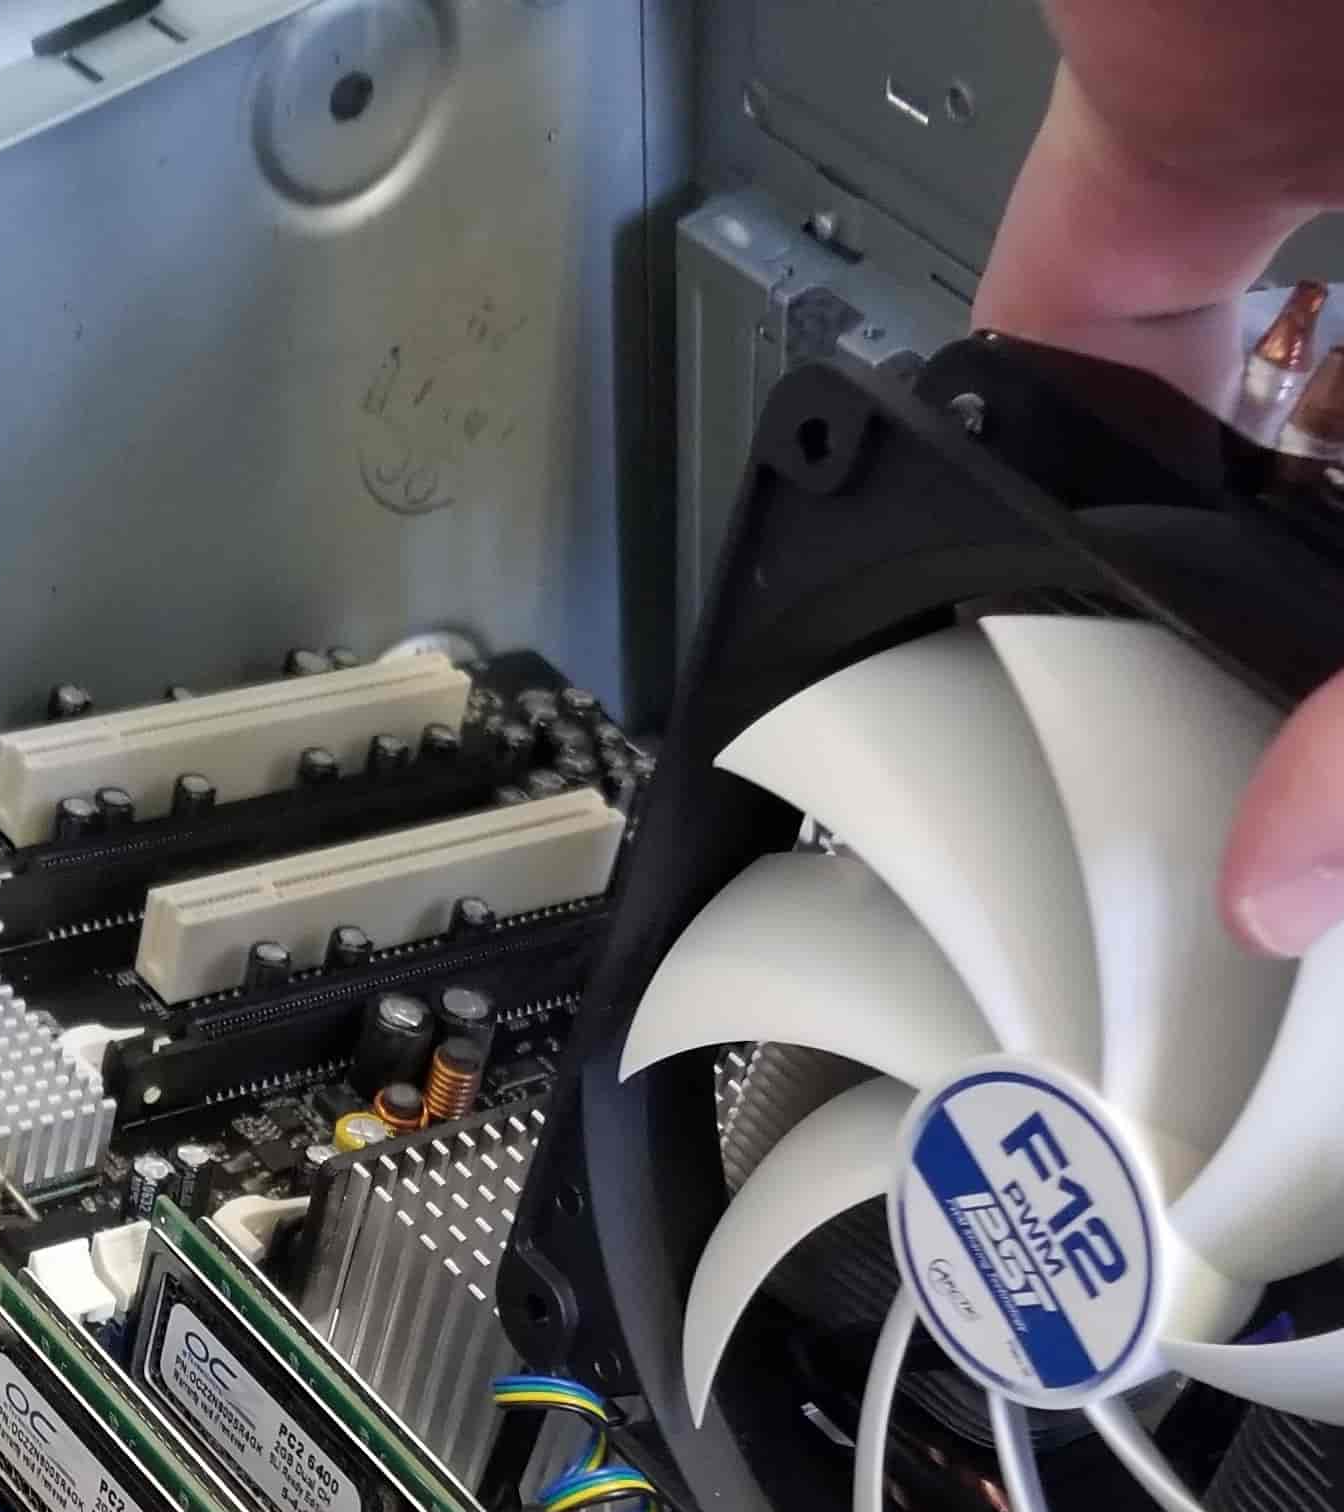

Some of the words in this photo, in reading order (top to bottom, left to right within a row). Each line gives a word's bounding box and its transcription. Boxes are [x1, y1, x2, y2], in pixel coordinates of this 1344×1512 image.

[1000, 1112, 1127, 1299] F12
[1002, 1181, 1065, 1276] PWM
[273, 1438, 293, 1466] 2GB
[294, 1461, 316, 1490] Dual
[316, 1485, 331, 1507] CH
[277, 1421, 305, 1459] PC2
[306, 1452, 339, 1496] 6400
